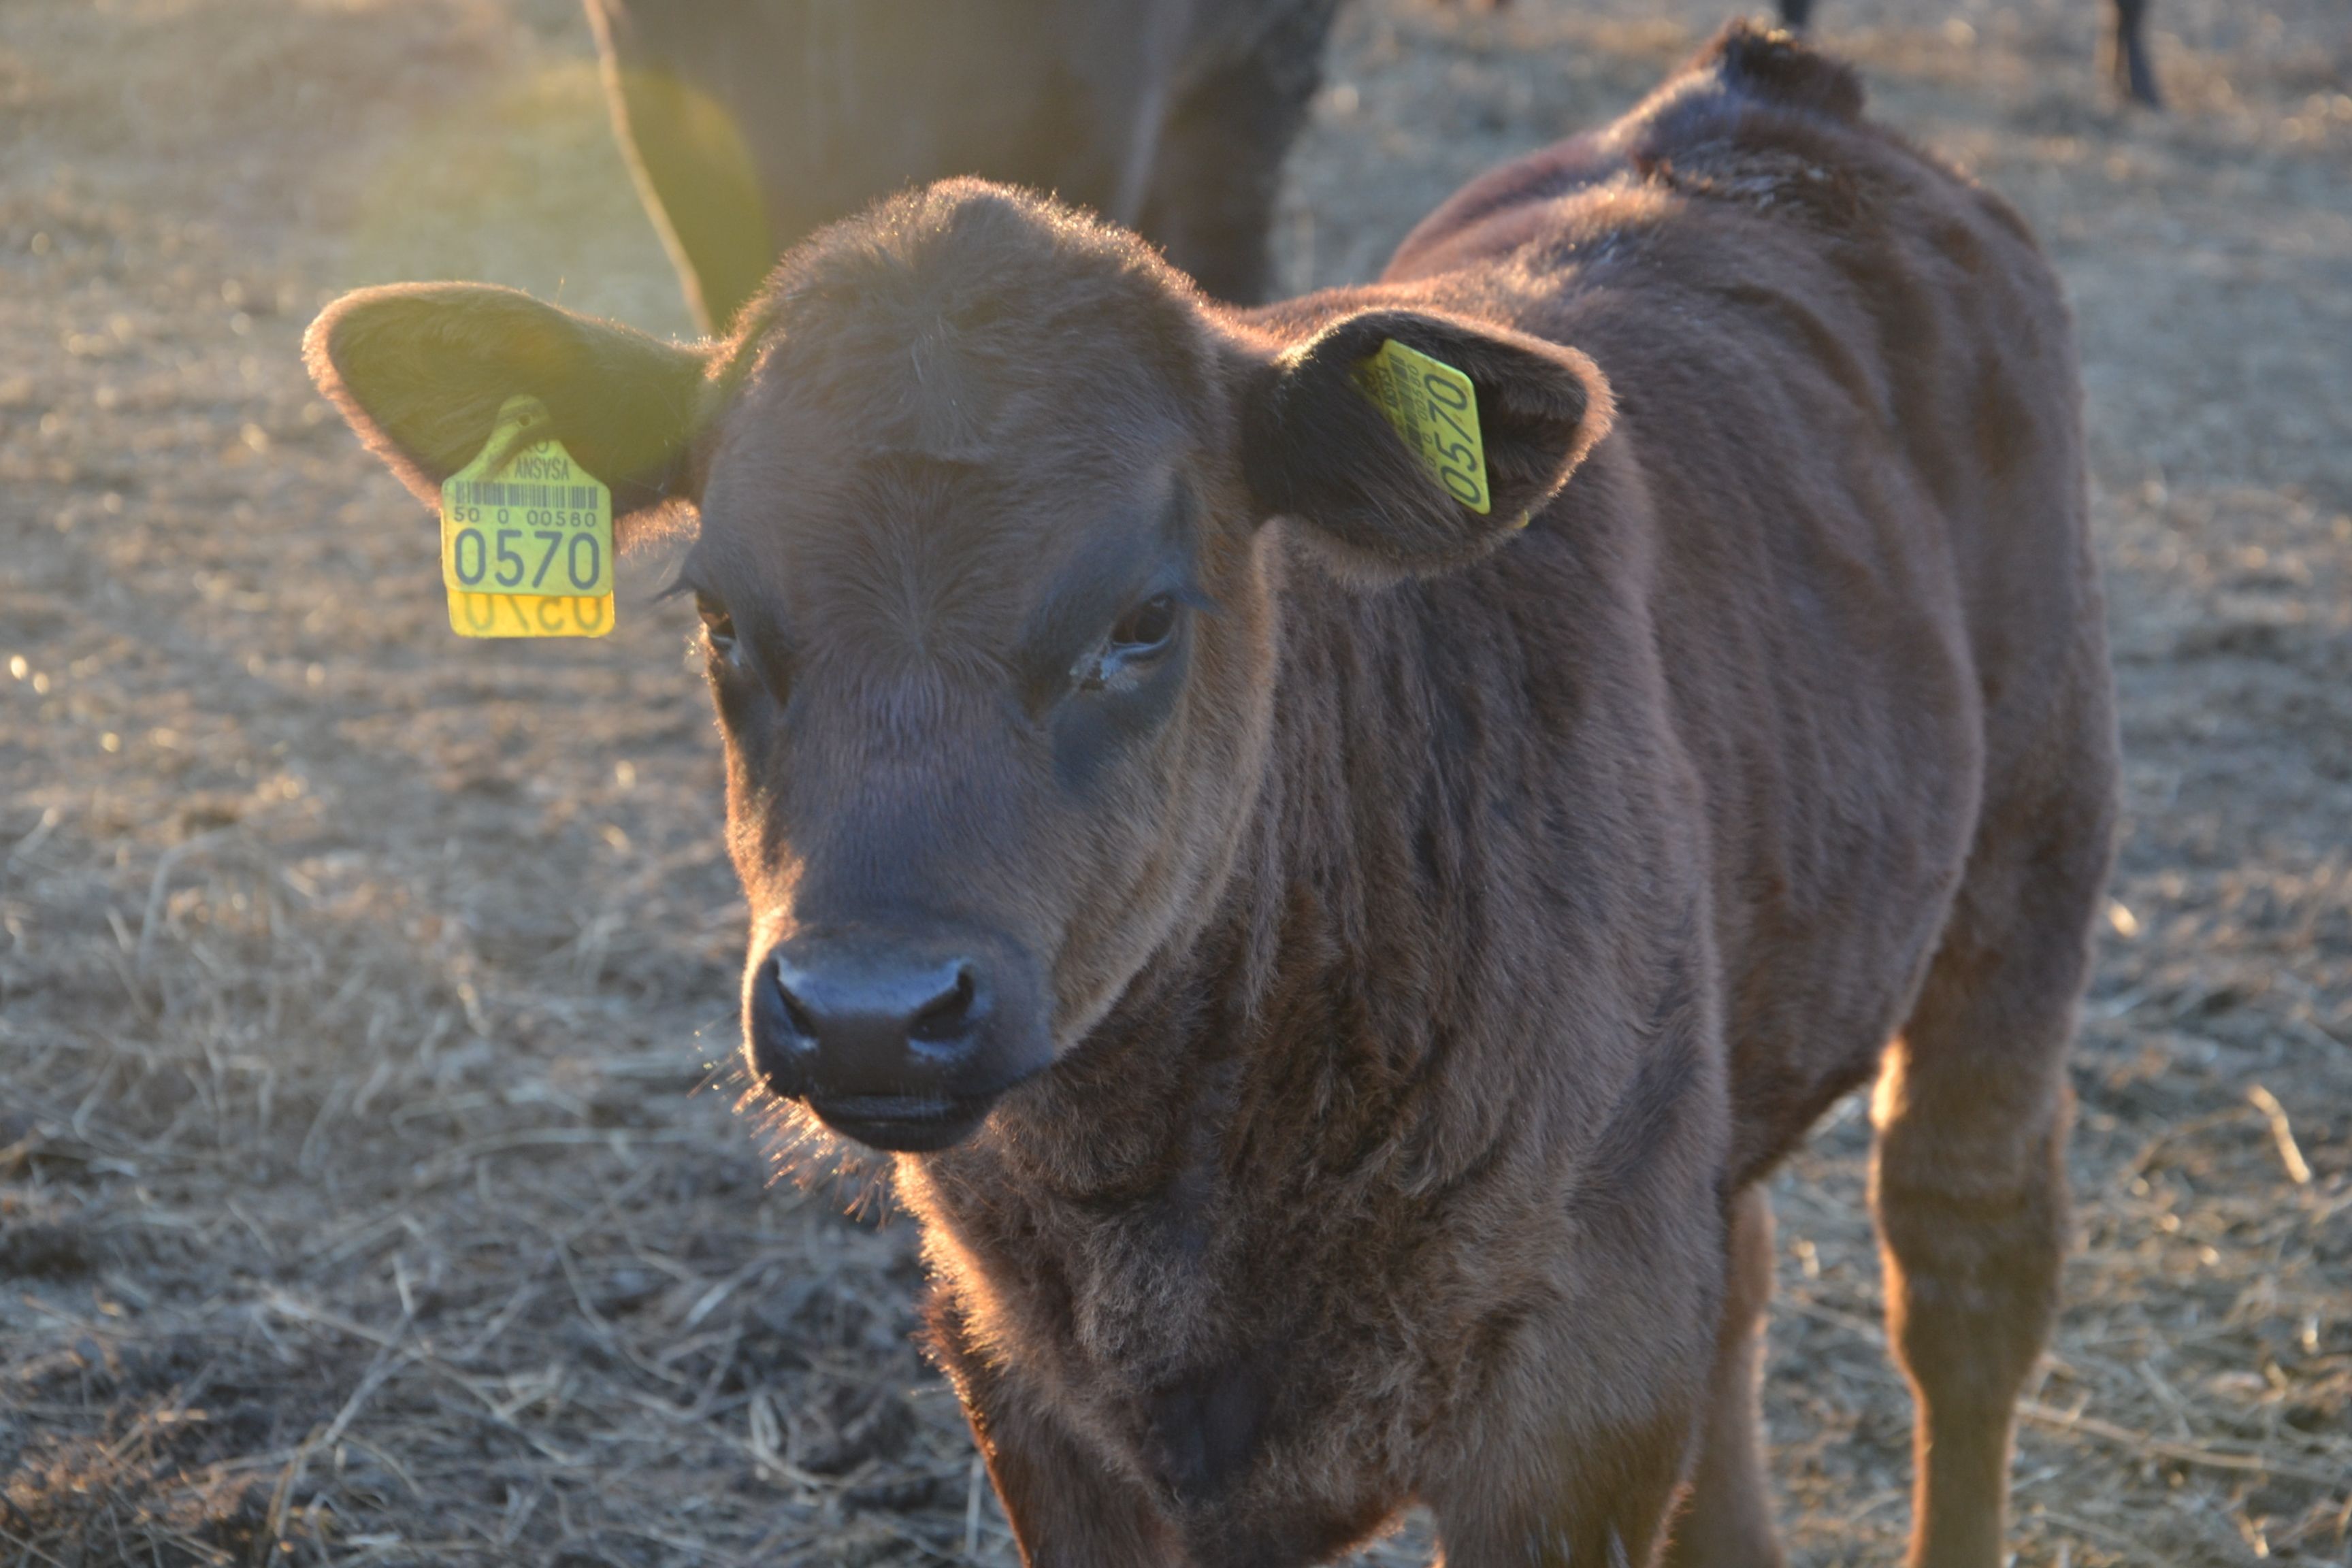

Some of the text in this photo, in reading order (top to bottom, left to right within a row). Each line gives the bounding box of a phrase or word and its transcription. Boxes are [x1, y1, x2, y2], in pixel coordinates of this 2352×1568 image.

[1423, 373, 1481, 505] 0570
[514, 457, 569, 480] ANSVSA
[454, 506, 597, 528] 50 0 00580
[455, 528, 600, 590] 0570
